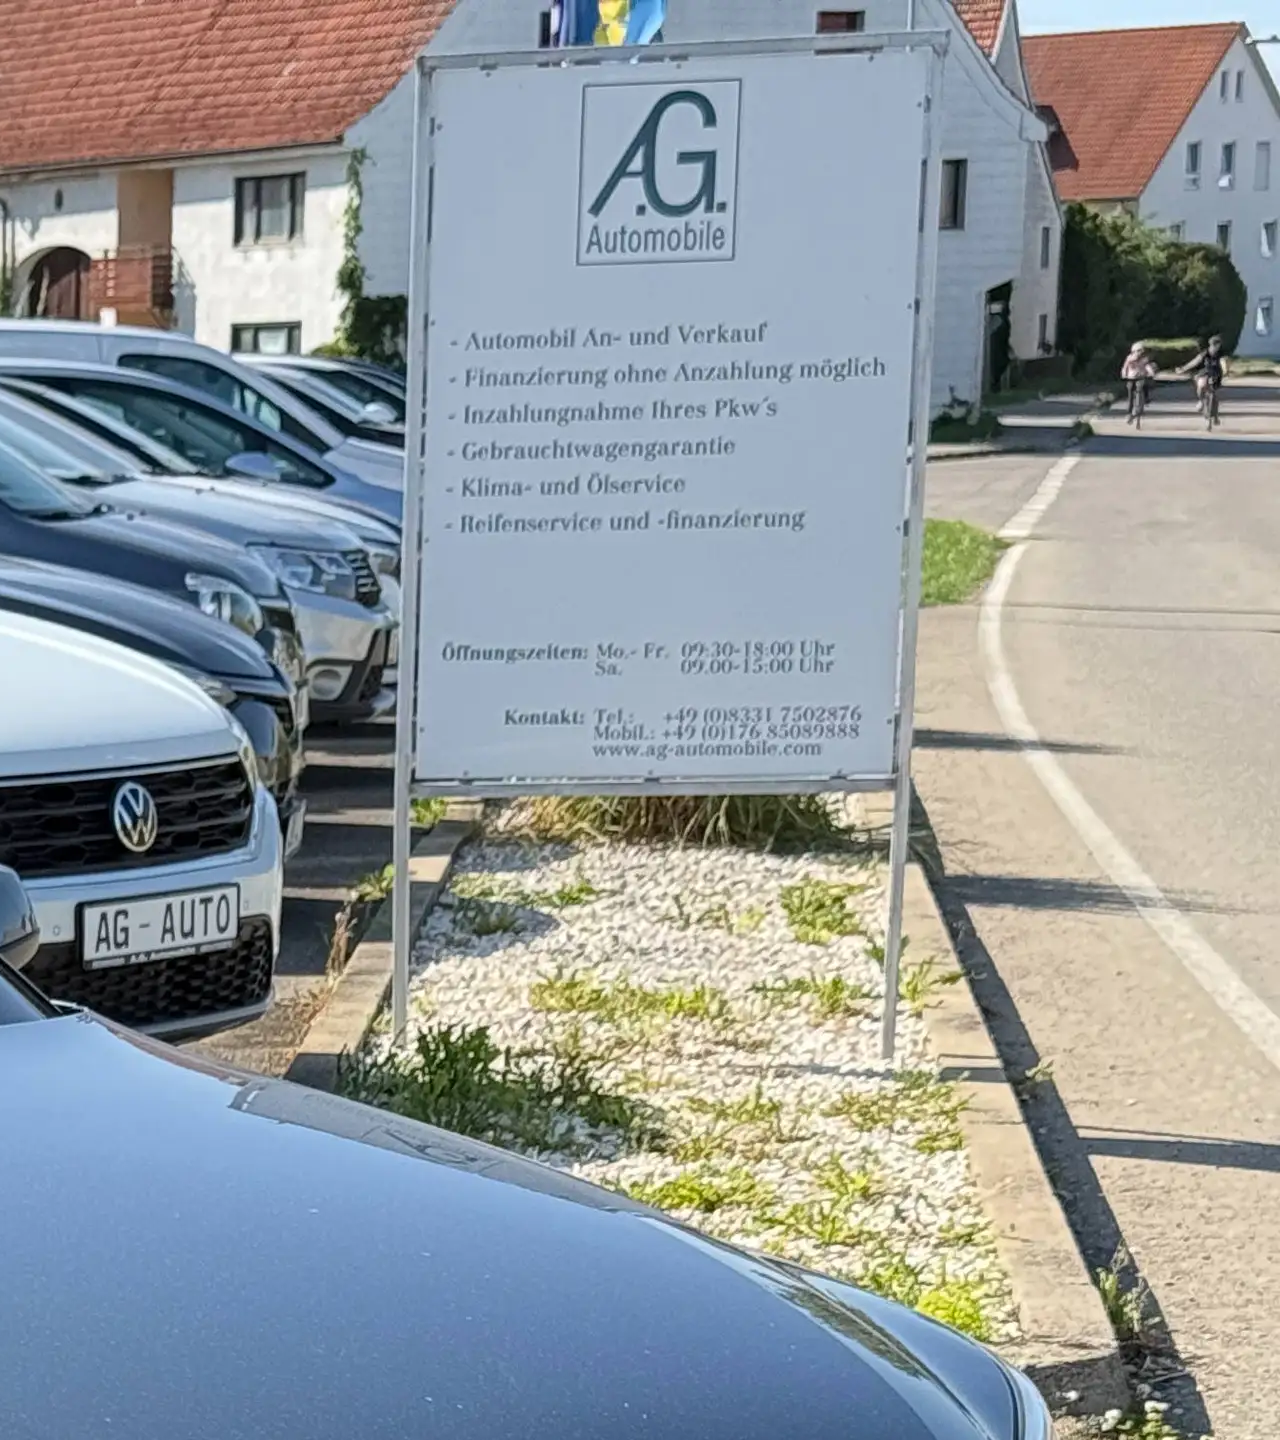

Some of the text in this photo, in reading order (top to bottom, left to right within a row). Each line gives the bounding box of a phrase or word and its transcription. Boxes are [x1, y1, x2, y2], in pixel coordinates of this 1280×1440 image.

[586, 222, 726, 254] Automobile
[464, 321, 768, 351] Automobil An- und Verkauf
[465, 357, 886, 389] Finanzierung ohne Anzahlung möglich
[464, 401, 644, 427] Inzahlungnahme
[651, 399, 707, 420] Ihres
[461, 436, 736, 463] Gebrauchtwagengarantie
[461, 473, 686, 497] Klima- und Ölservice
[460, 509, 807, 534] Reifenservice und -finanzierung
[442, 641, 589, 664] Öffnungszeiten:
[643, 642, 670, 660] Fr.
[799, 639, 836, 658] Uhr
[595, 660, 623, 676] Sa.
[799, 657, 835, 674] Uhr
[504, 708, 585, 726] Kontakt:
[664, 707, 698, 725] +49
[703, 706, 772, 727] (0)8331
[780, 705, 862, 723] 7502876
[662, 725, 697, 742] +49
[701, 723, 761, 743] (0)176
[592, 740, 823, 761] www.ag-automobile.com
[95, 909, 130, 954] AG
[160, 893, 231, 944] AUTO
